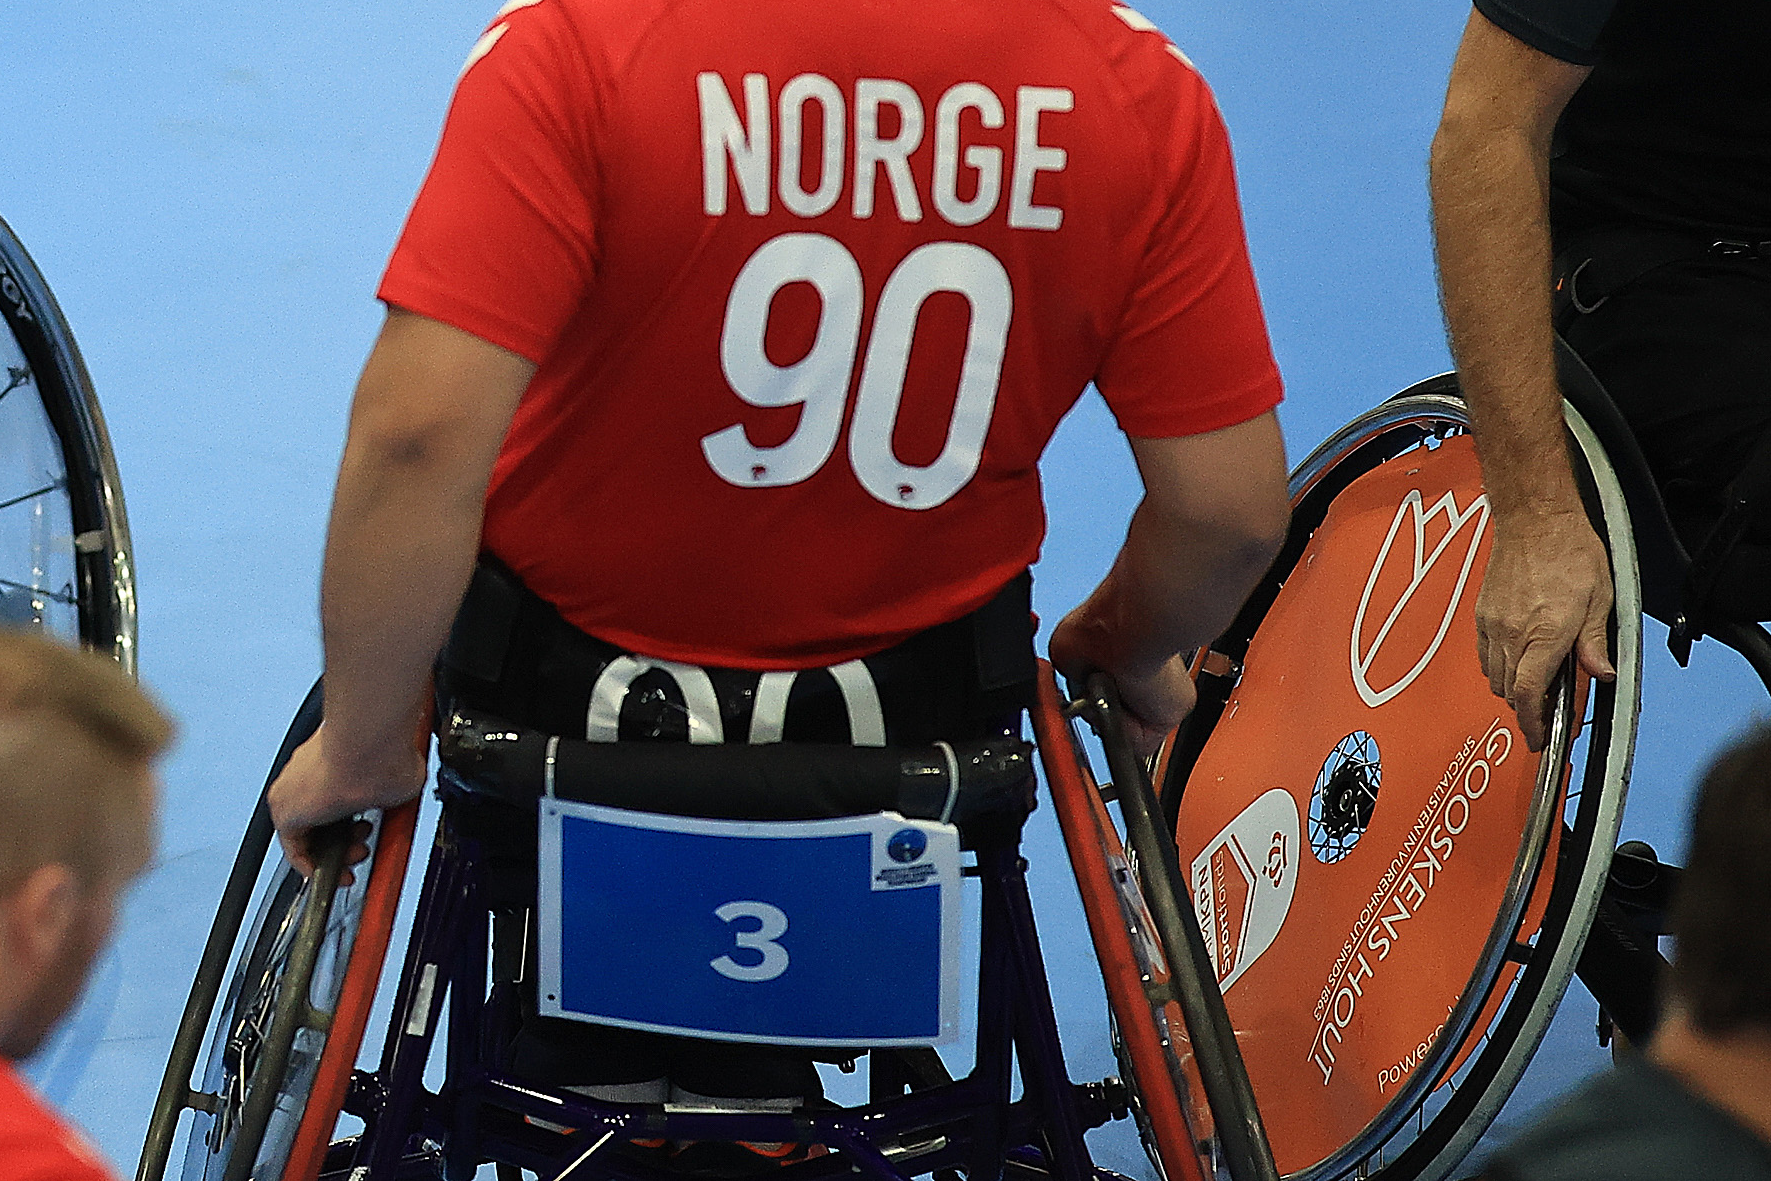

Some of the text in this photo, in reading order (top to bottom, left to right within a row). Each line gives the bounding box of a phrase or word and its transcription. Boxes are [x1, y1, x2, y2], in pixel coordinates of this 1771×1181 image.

[696, 71, 1074, 231] NORGE
[701, 233, 1014, 511] 90
[709, 900, 790, 982] 3
[1214, 850, 1233, 976] Sportfonds
[1315, 727, 1513, 1086] GOOSKENS HOUT
[1328, 940, 1352, 987] SINDS
[1314, 984, 1331, 1022] 1863
